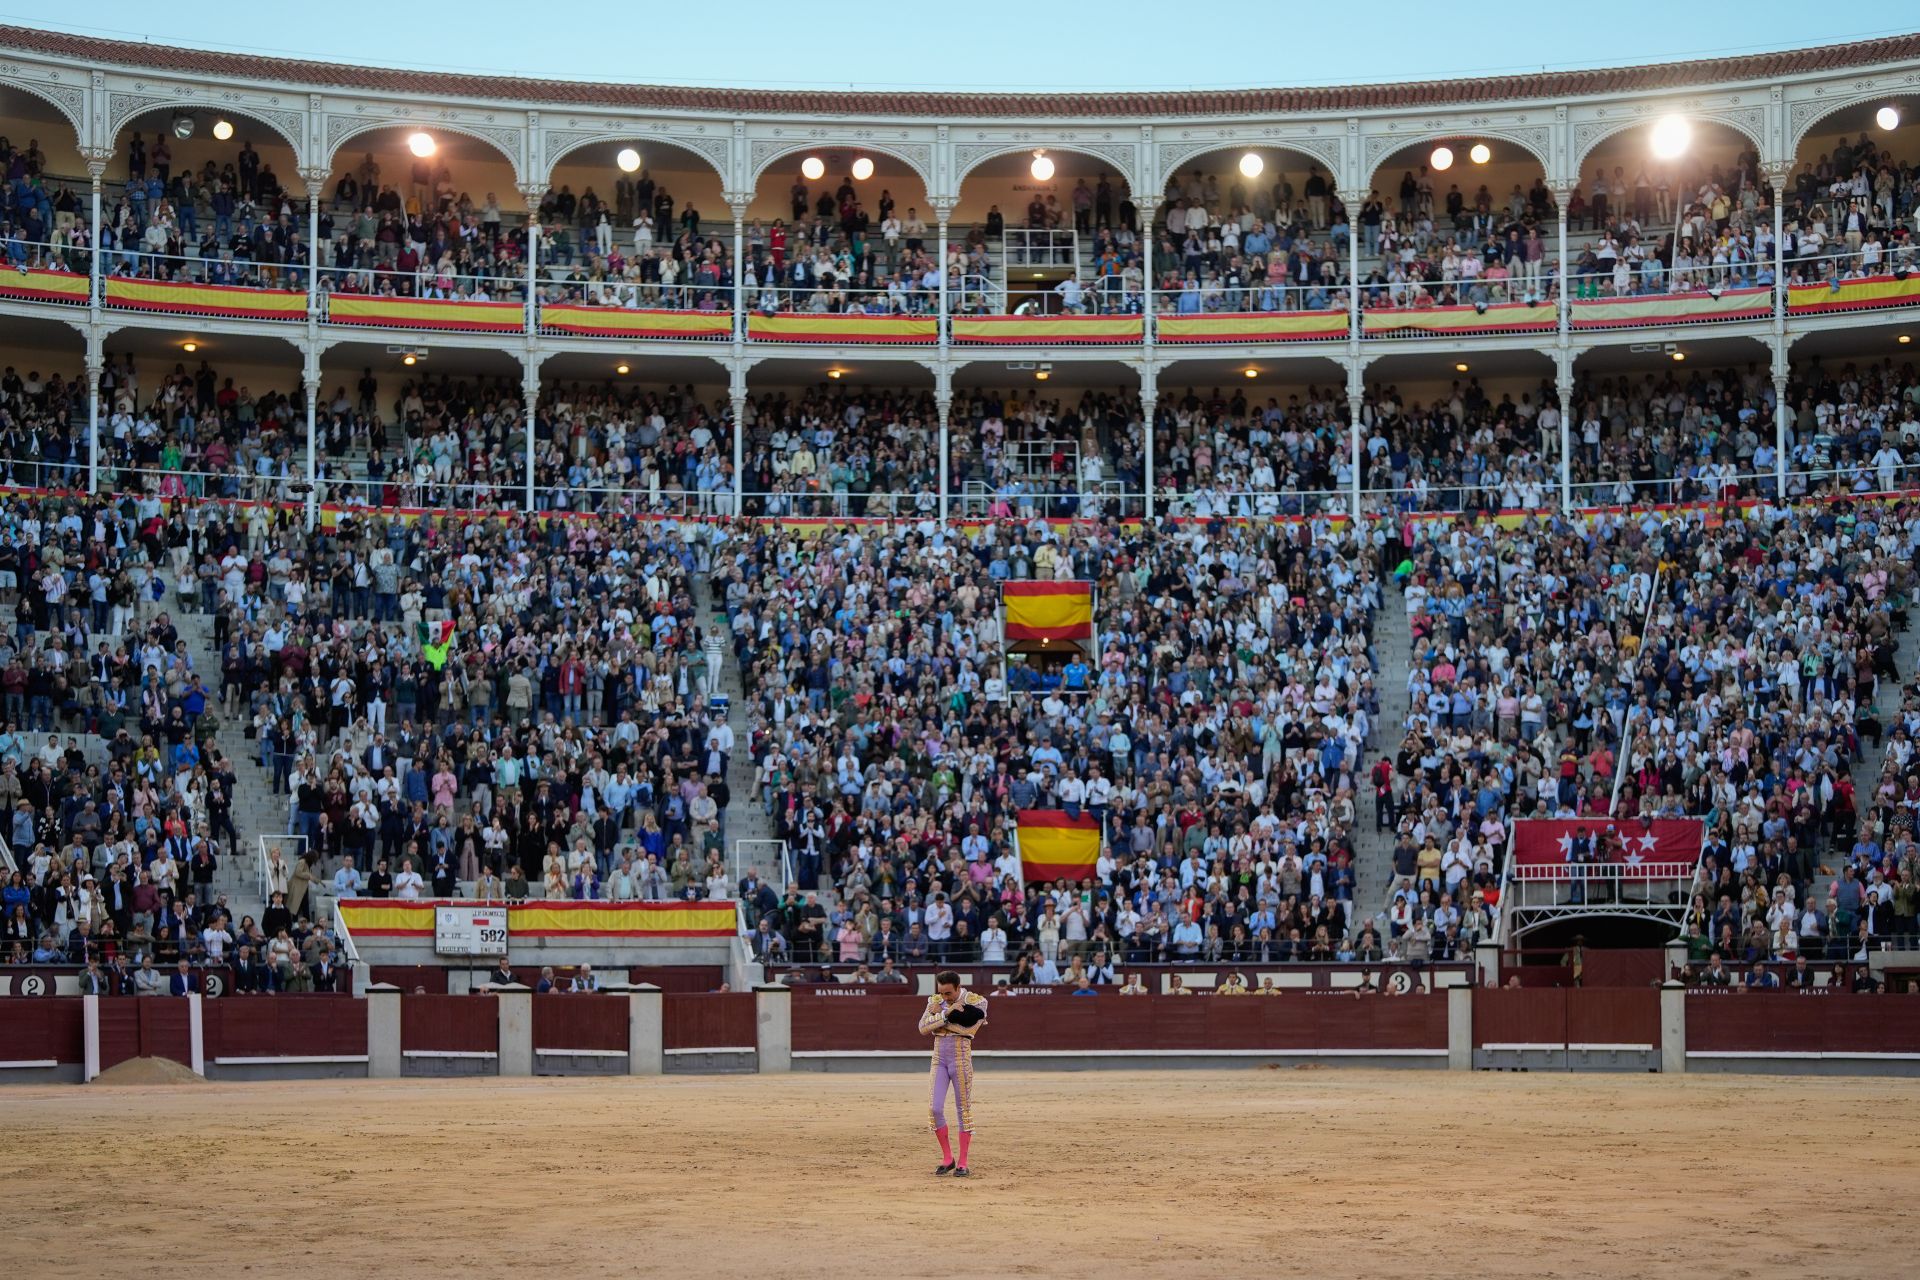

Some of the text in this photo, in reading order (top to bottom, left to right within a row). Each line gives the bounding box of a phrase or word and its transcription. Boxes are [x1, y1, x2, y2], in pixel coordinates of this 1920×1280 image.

[480, 929, 505, 943] 582
[28, 978, 38, 995] 2
[206, 977, 216, 995] 2
[1012, 987, 1053, 995] MEDICOS
[1395, 974, 1405, 991] 3
